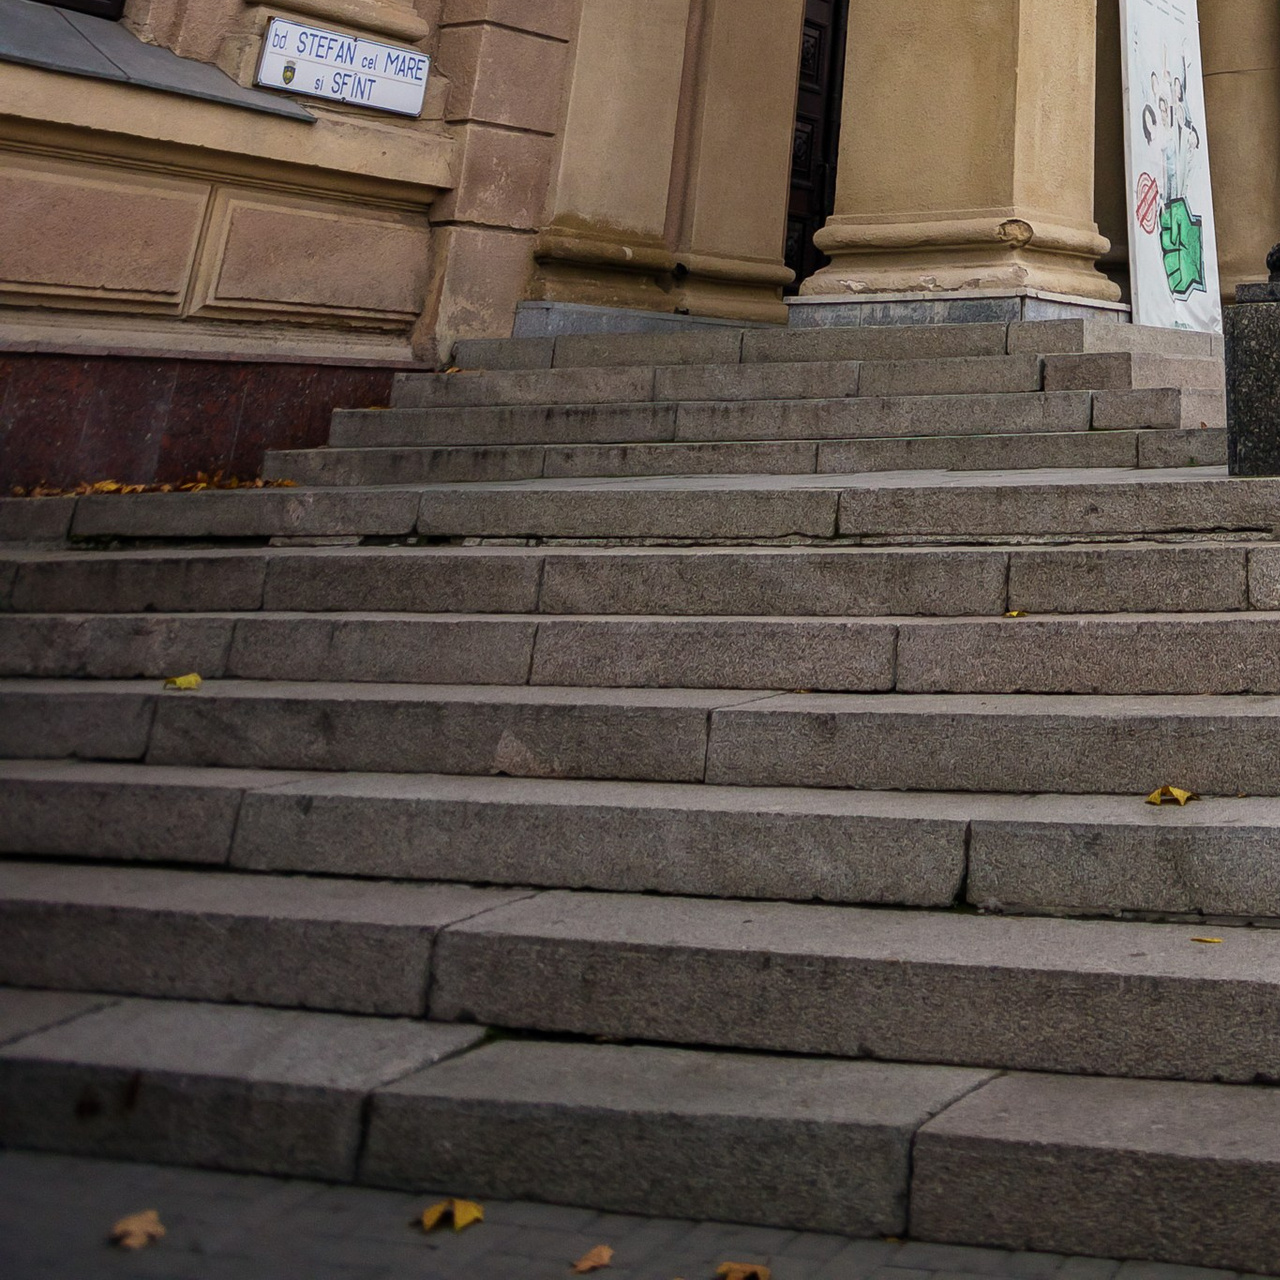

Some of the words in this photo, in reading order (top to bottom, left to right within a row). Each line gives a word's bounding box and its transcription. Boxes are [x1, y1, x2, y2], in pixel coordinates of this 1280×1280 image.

[272, 28, 288, 50] bd.
[361, 54, 378, 70] cel
[384, 52, 426, 81] MARE
[331, 72, 376, 101] SFÎNT
